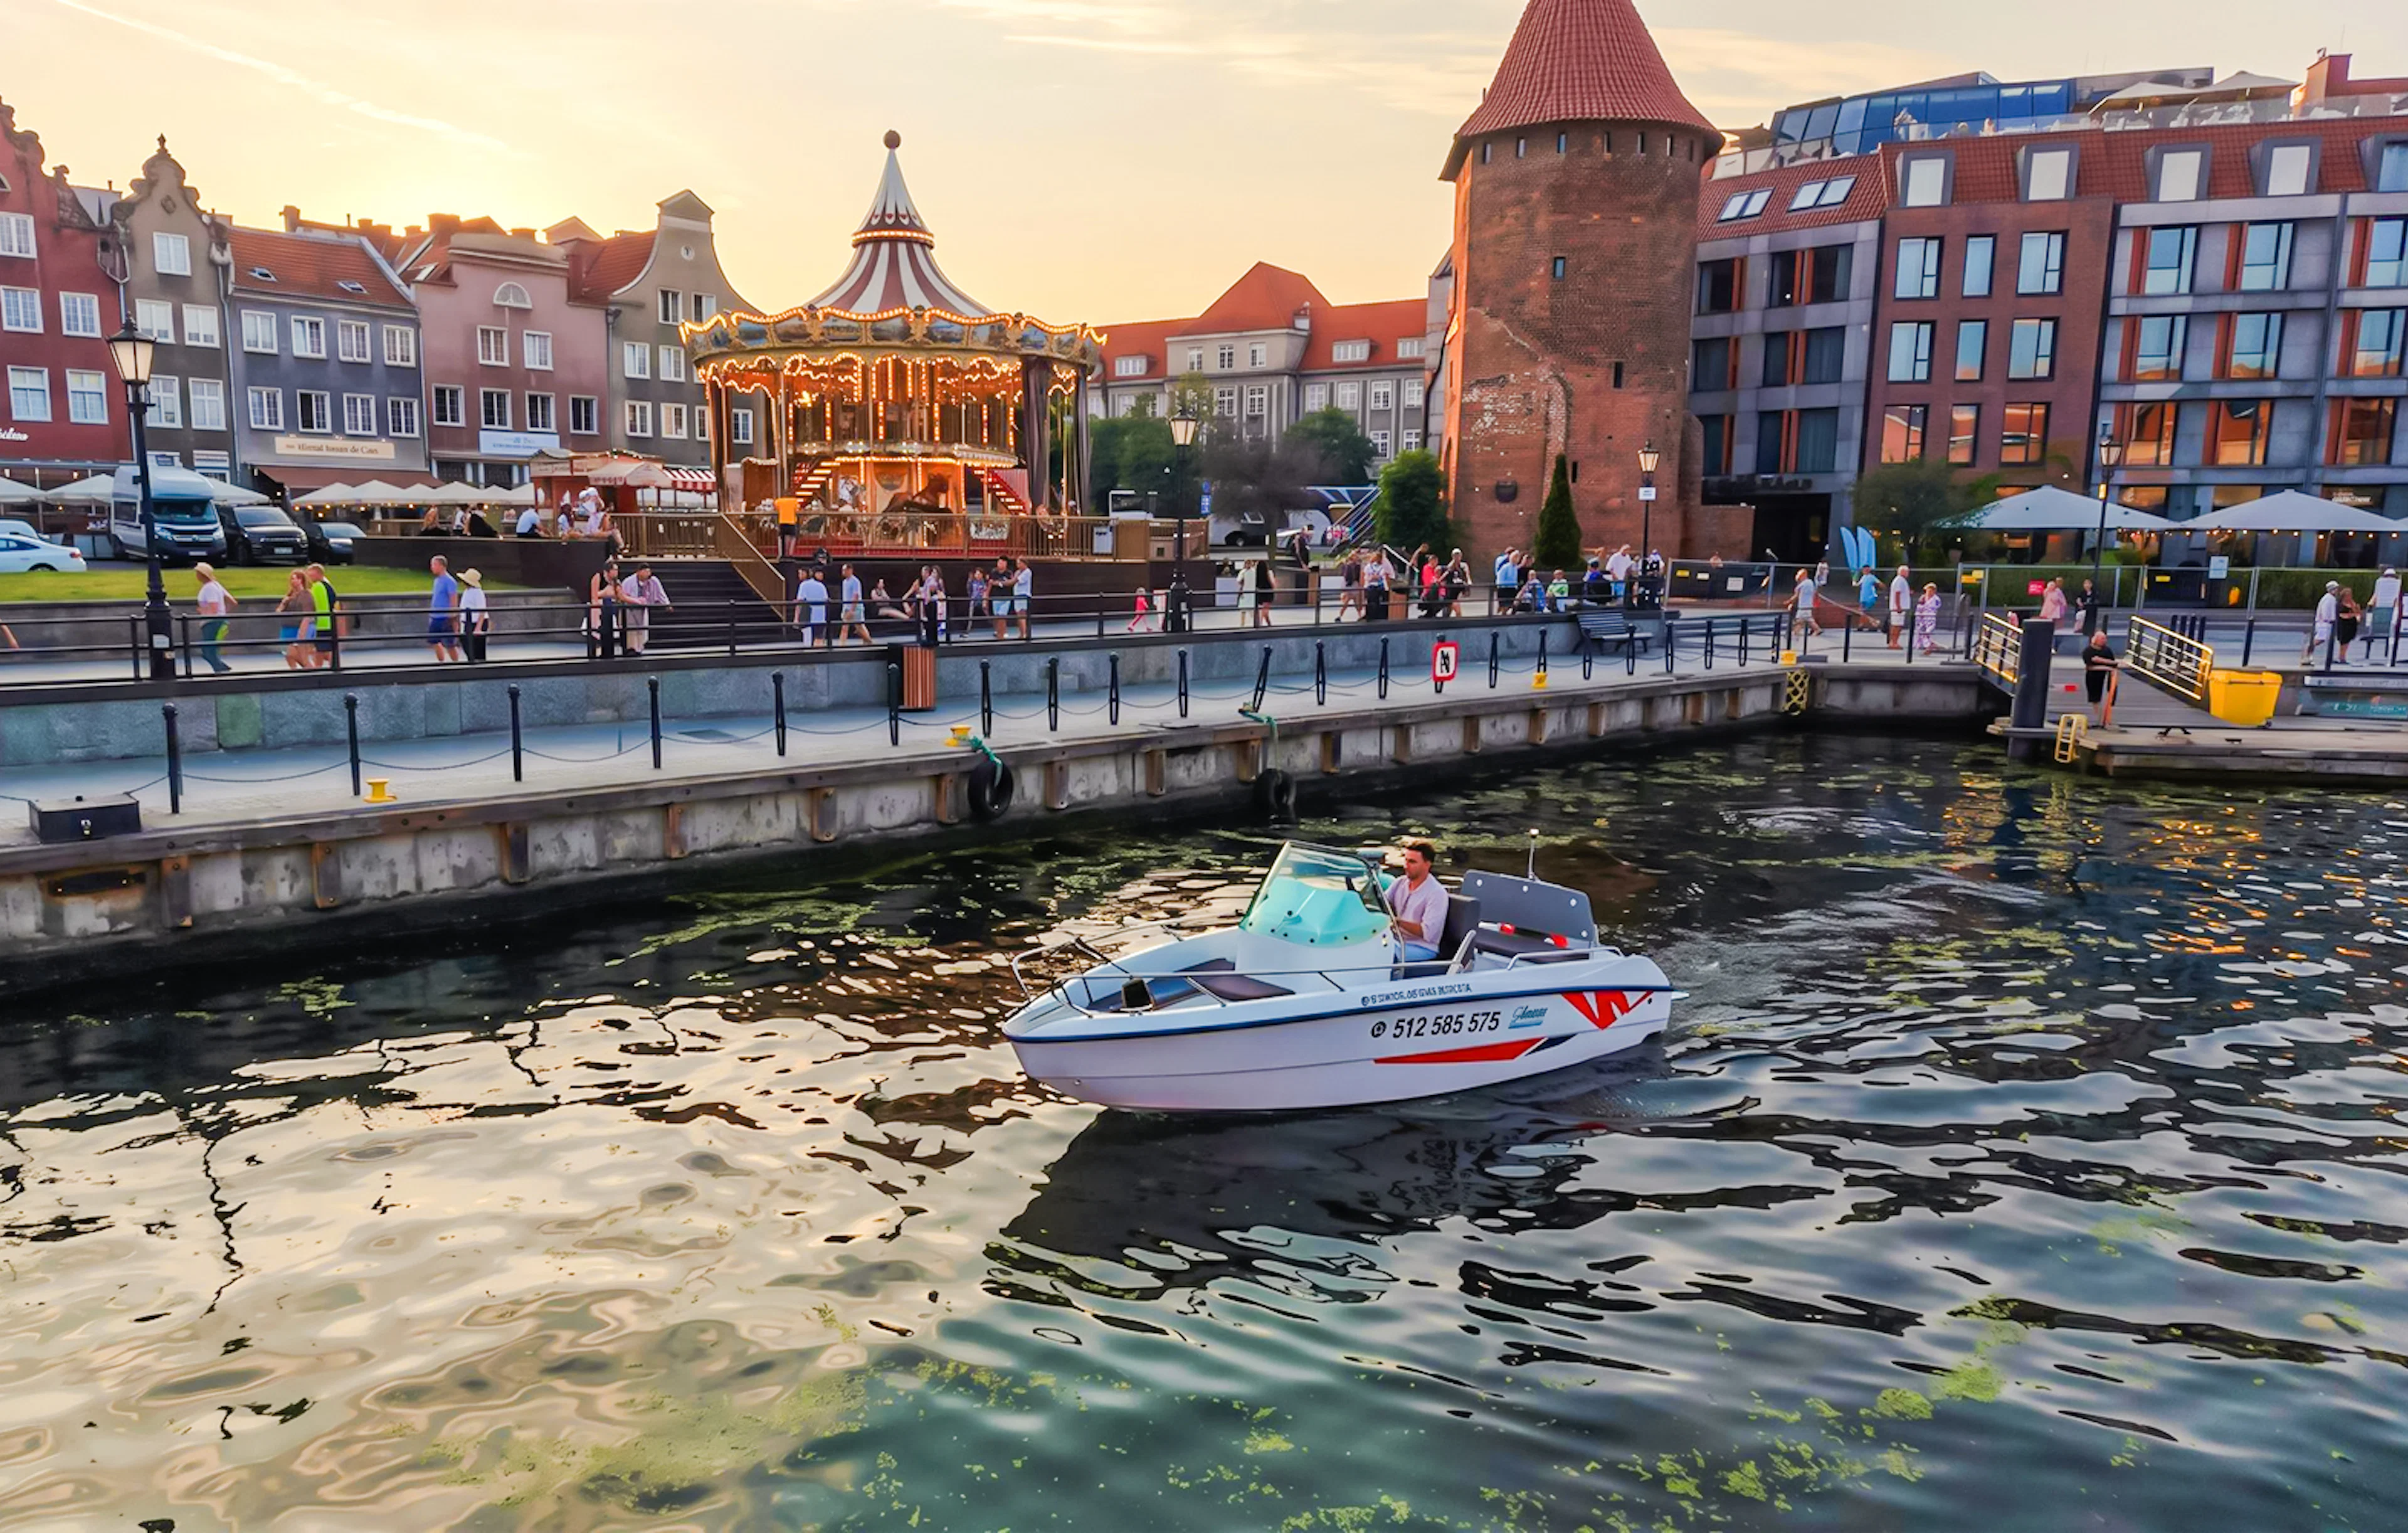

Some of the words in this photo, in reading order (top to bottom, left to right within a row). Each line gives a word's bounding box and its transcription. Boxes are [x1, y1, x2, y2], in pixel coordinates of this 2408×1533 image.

[1393, 1016, 1427, 1038] 512
[1431, 1014, 1464, 1035] 585
[1468, 1012, 1501, 1032] 575
